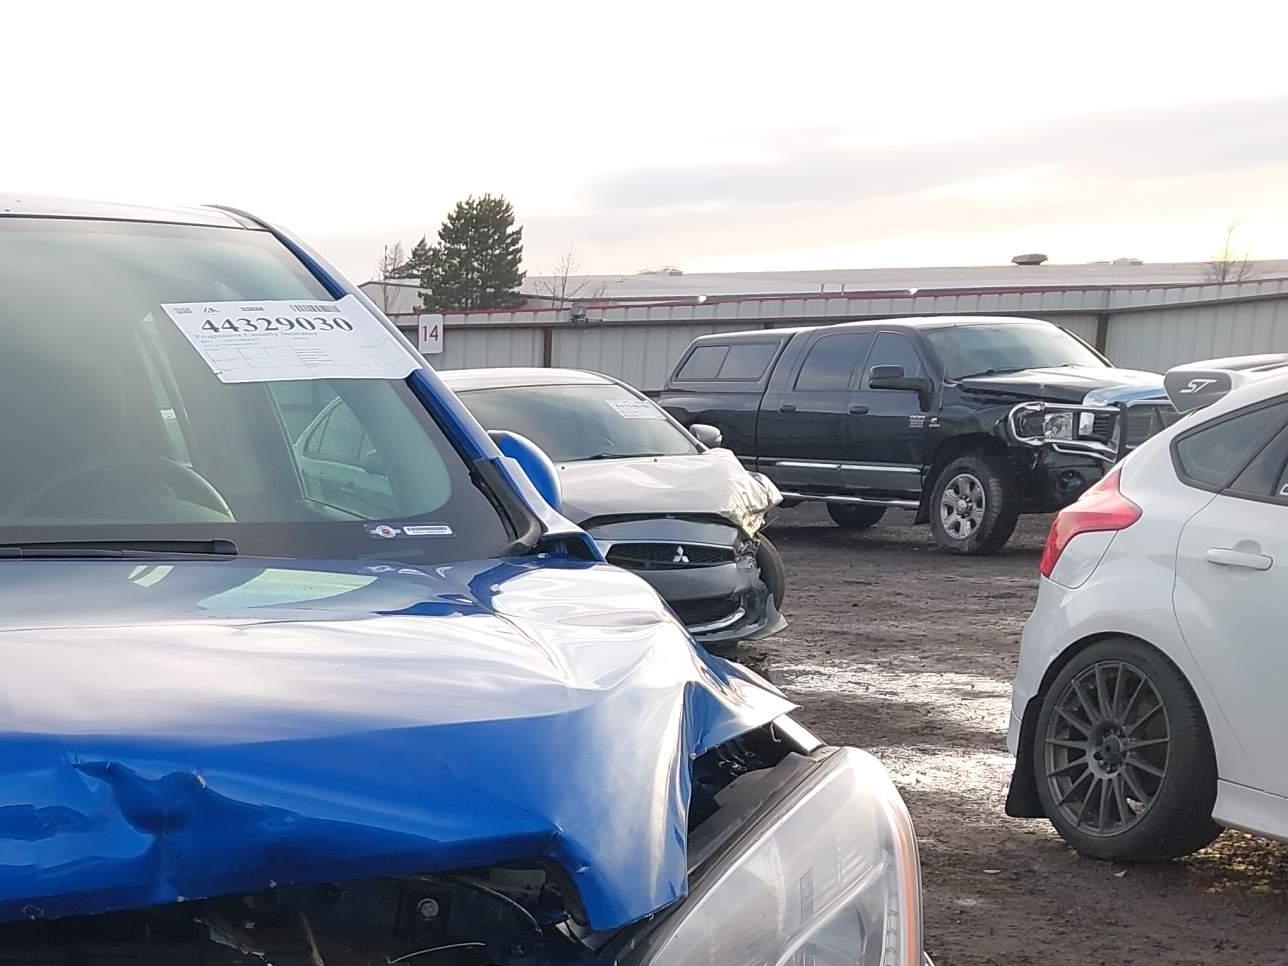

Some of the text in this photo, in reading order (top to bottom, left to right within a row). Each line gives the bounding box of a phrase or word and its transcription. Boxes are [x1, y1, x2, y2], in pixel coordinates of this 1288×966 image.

[201, 316, 354, 332] 44329030
[422, 324, 439, 342] 14
[1179, 378, 1219, 393] ST
